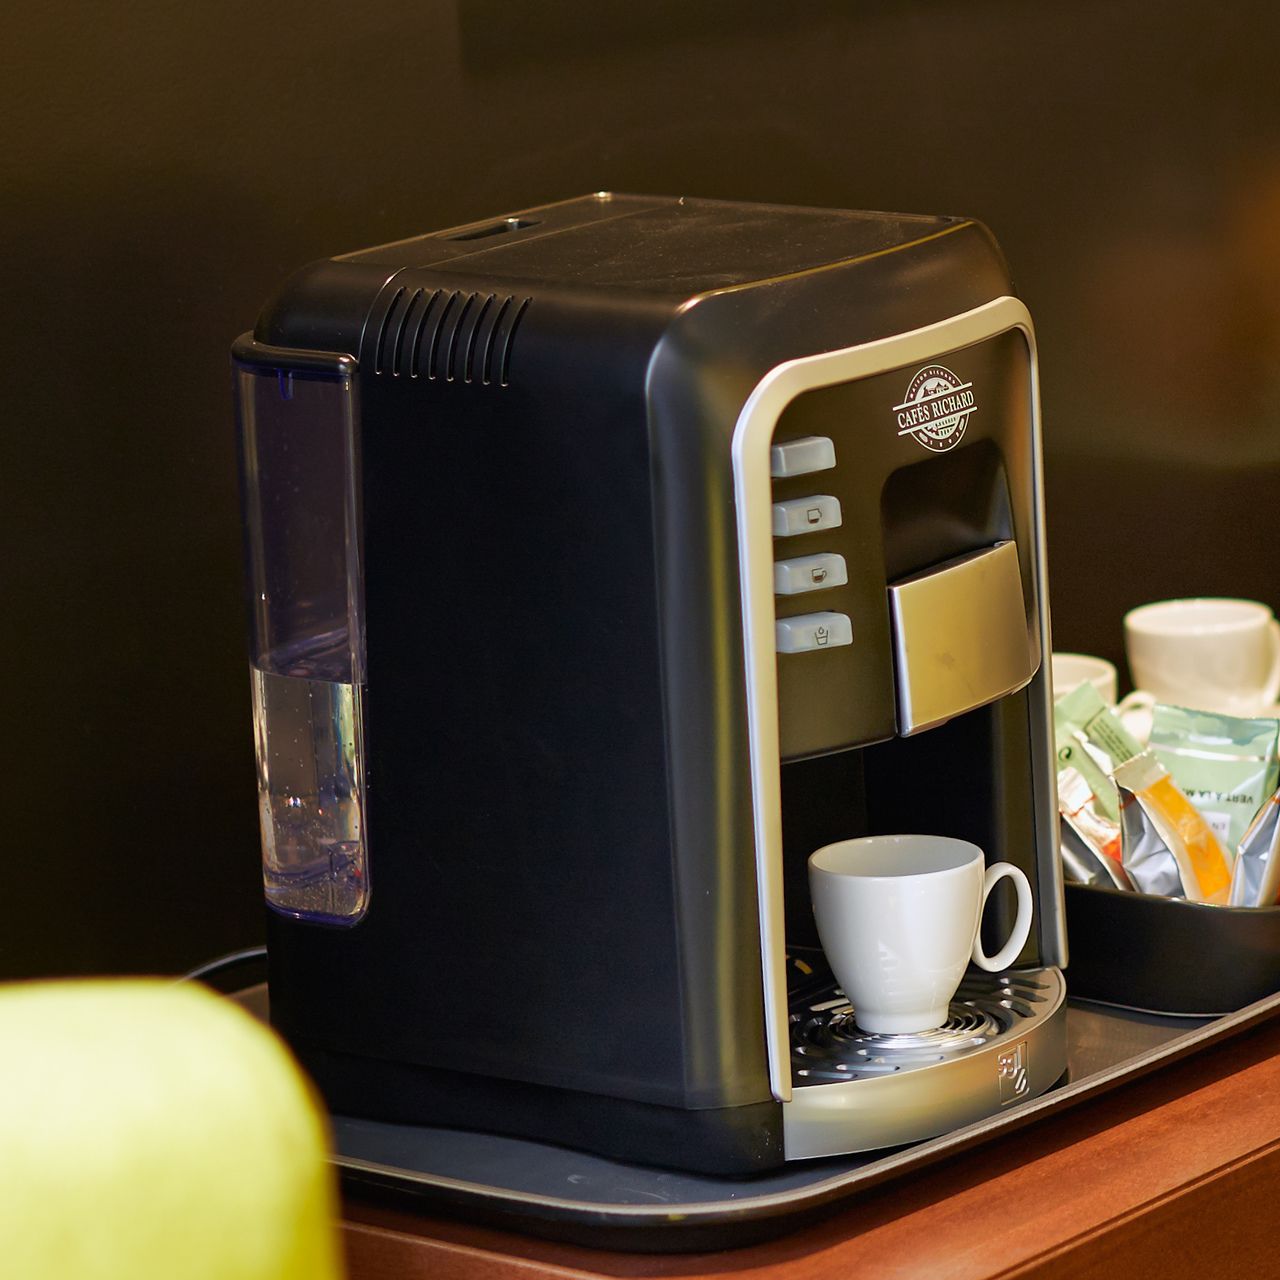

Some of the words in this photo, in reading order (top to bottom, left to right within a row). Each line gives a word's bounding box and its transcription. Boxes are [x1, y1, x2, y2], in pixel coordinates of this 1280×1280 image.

[897, 403, 931, 429] CAFÉS
[931, 390, 974, 418] RICHARD
[1226, 794, 1254, 804] VERT
